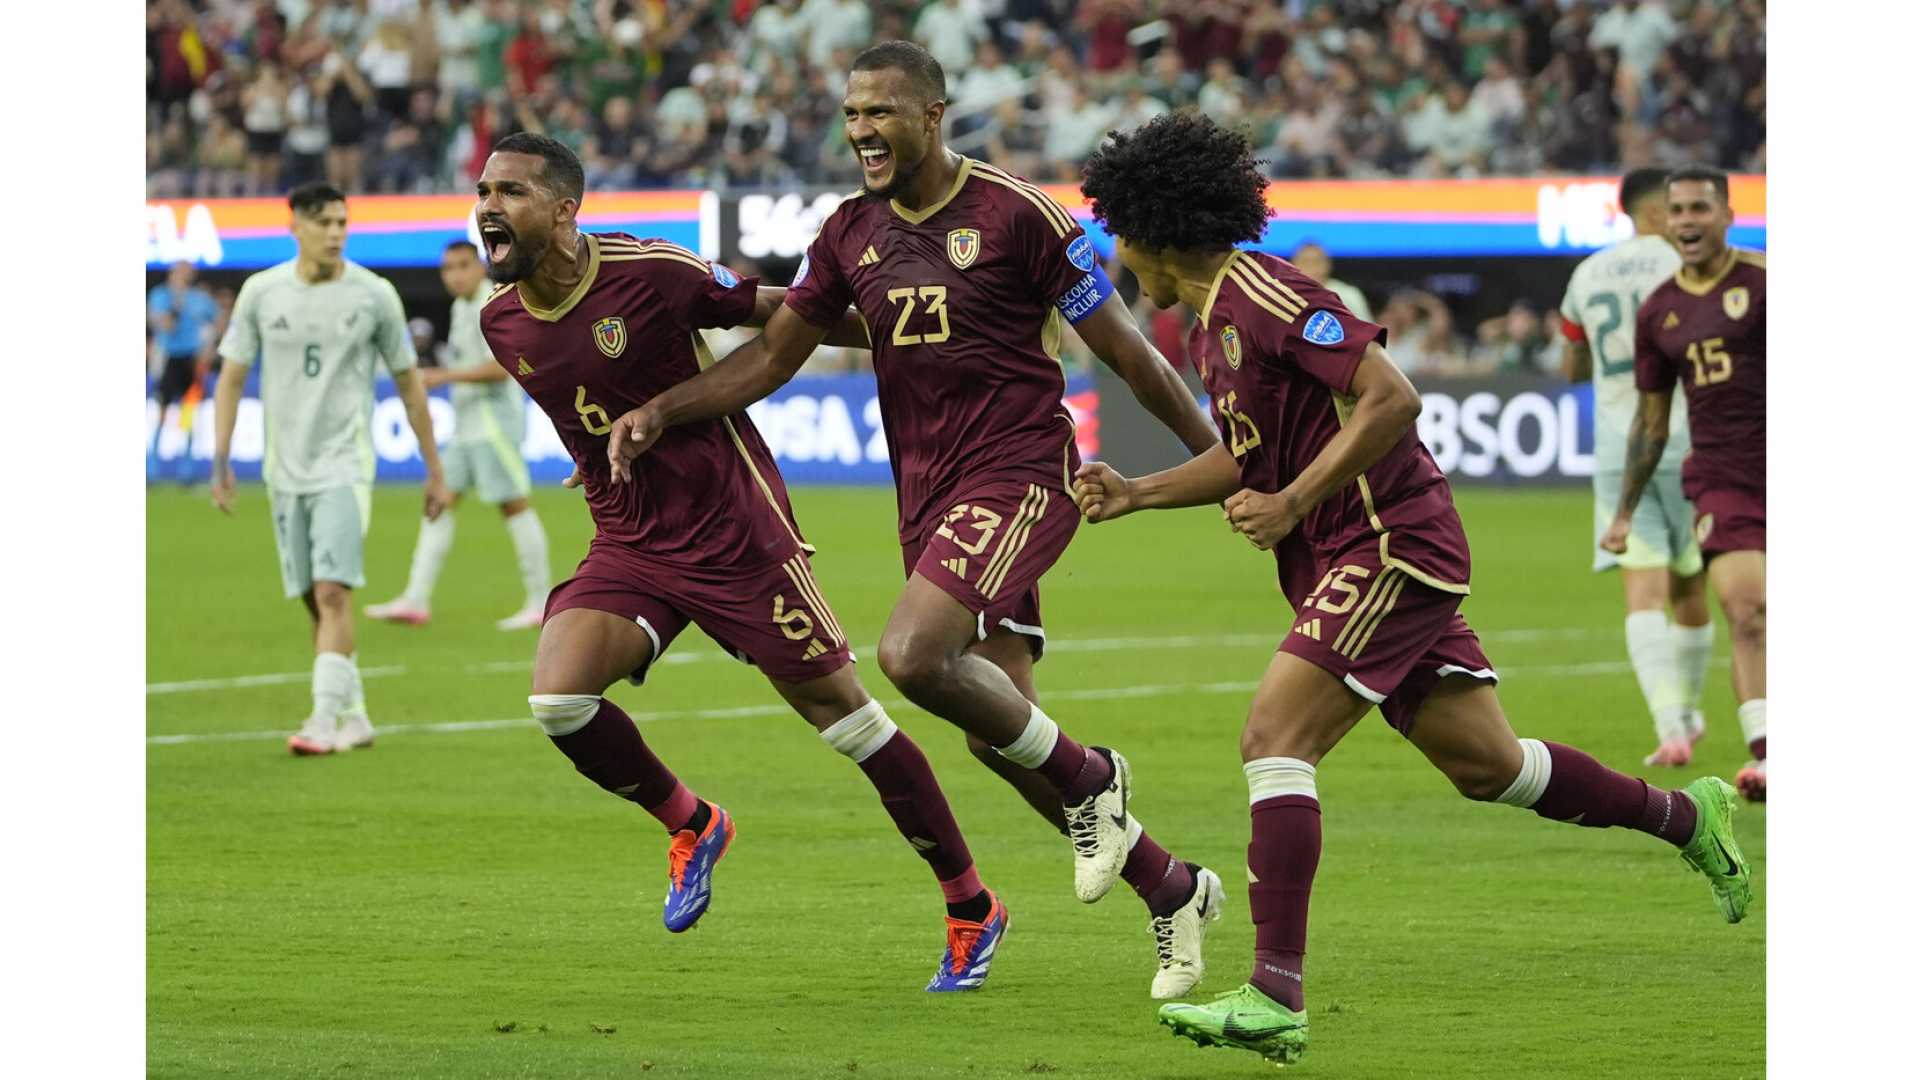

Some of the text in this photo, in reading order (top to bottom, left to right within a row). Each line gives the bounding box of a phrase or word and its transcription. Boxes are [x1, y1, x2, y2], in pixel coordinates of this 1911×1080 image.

[887, 286, 951, 346] 23
[1056, 273, 1096, 309] SCOLHA
[1064, 289, 1102, 320] INCLUIR
[1587, 291, 1643, 376] 2
[304, 344, 321, 378] 6
[1686, 338, 1732, 387] 15
[575, 385, 612, 436] 6
[1416, 392, 1596, 478] BSOL
[935, 504, 1003, 556] 23
[1303, 564, 1371, 616] 25
[773, 594, 814, 641] 6
